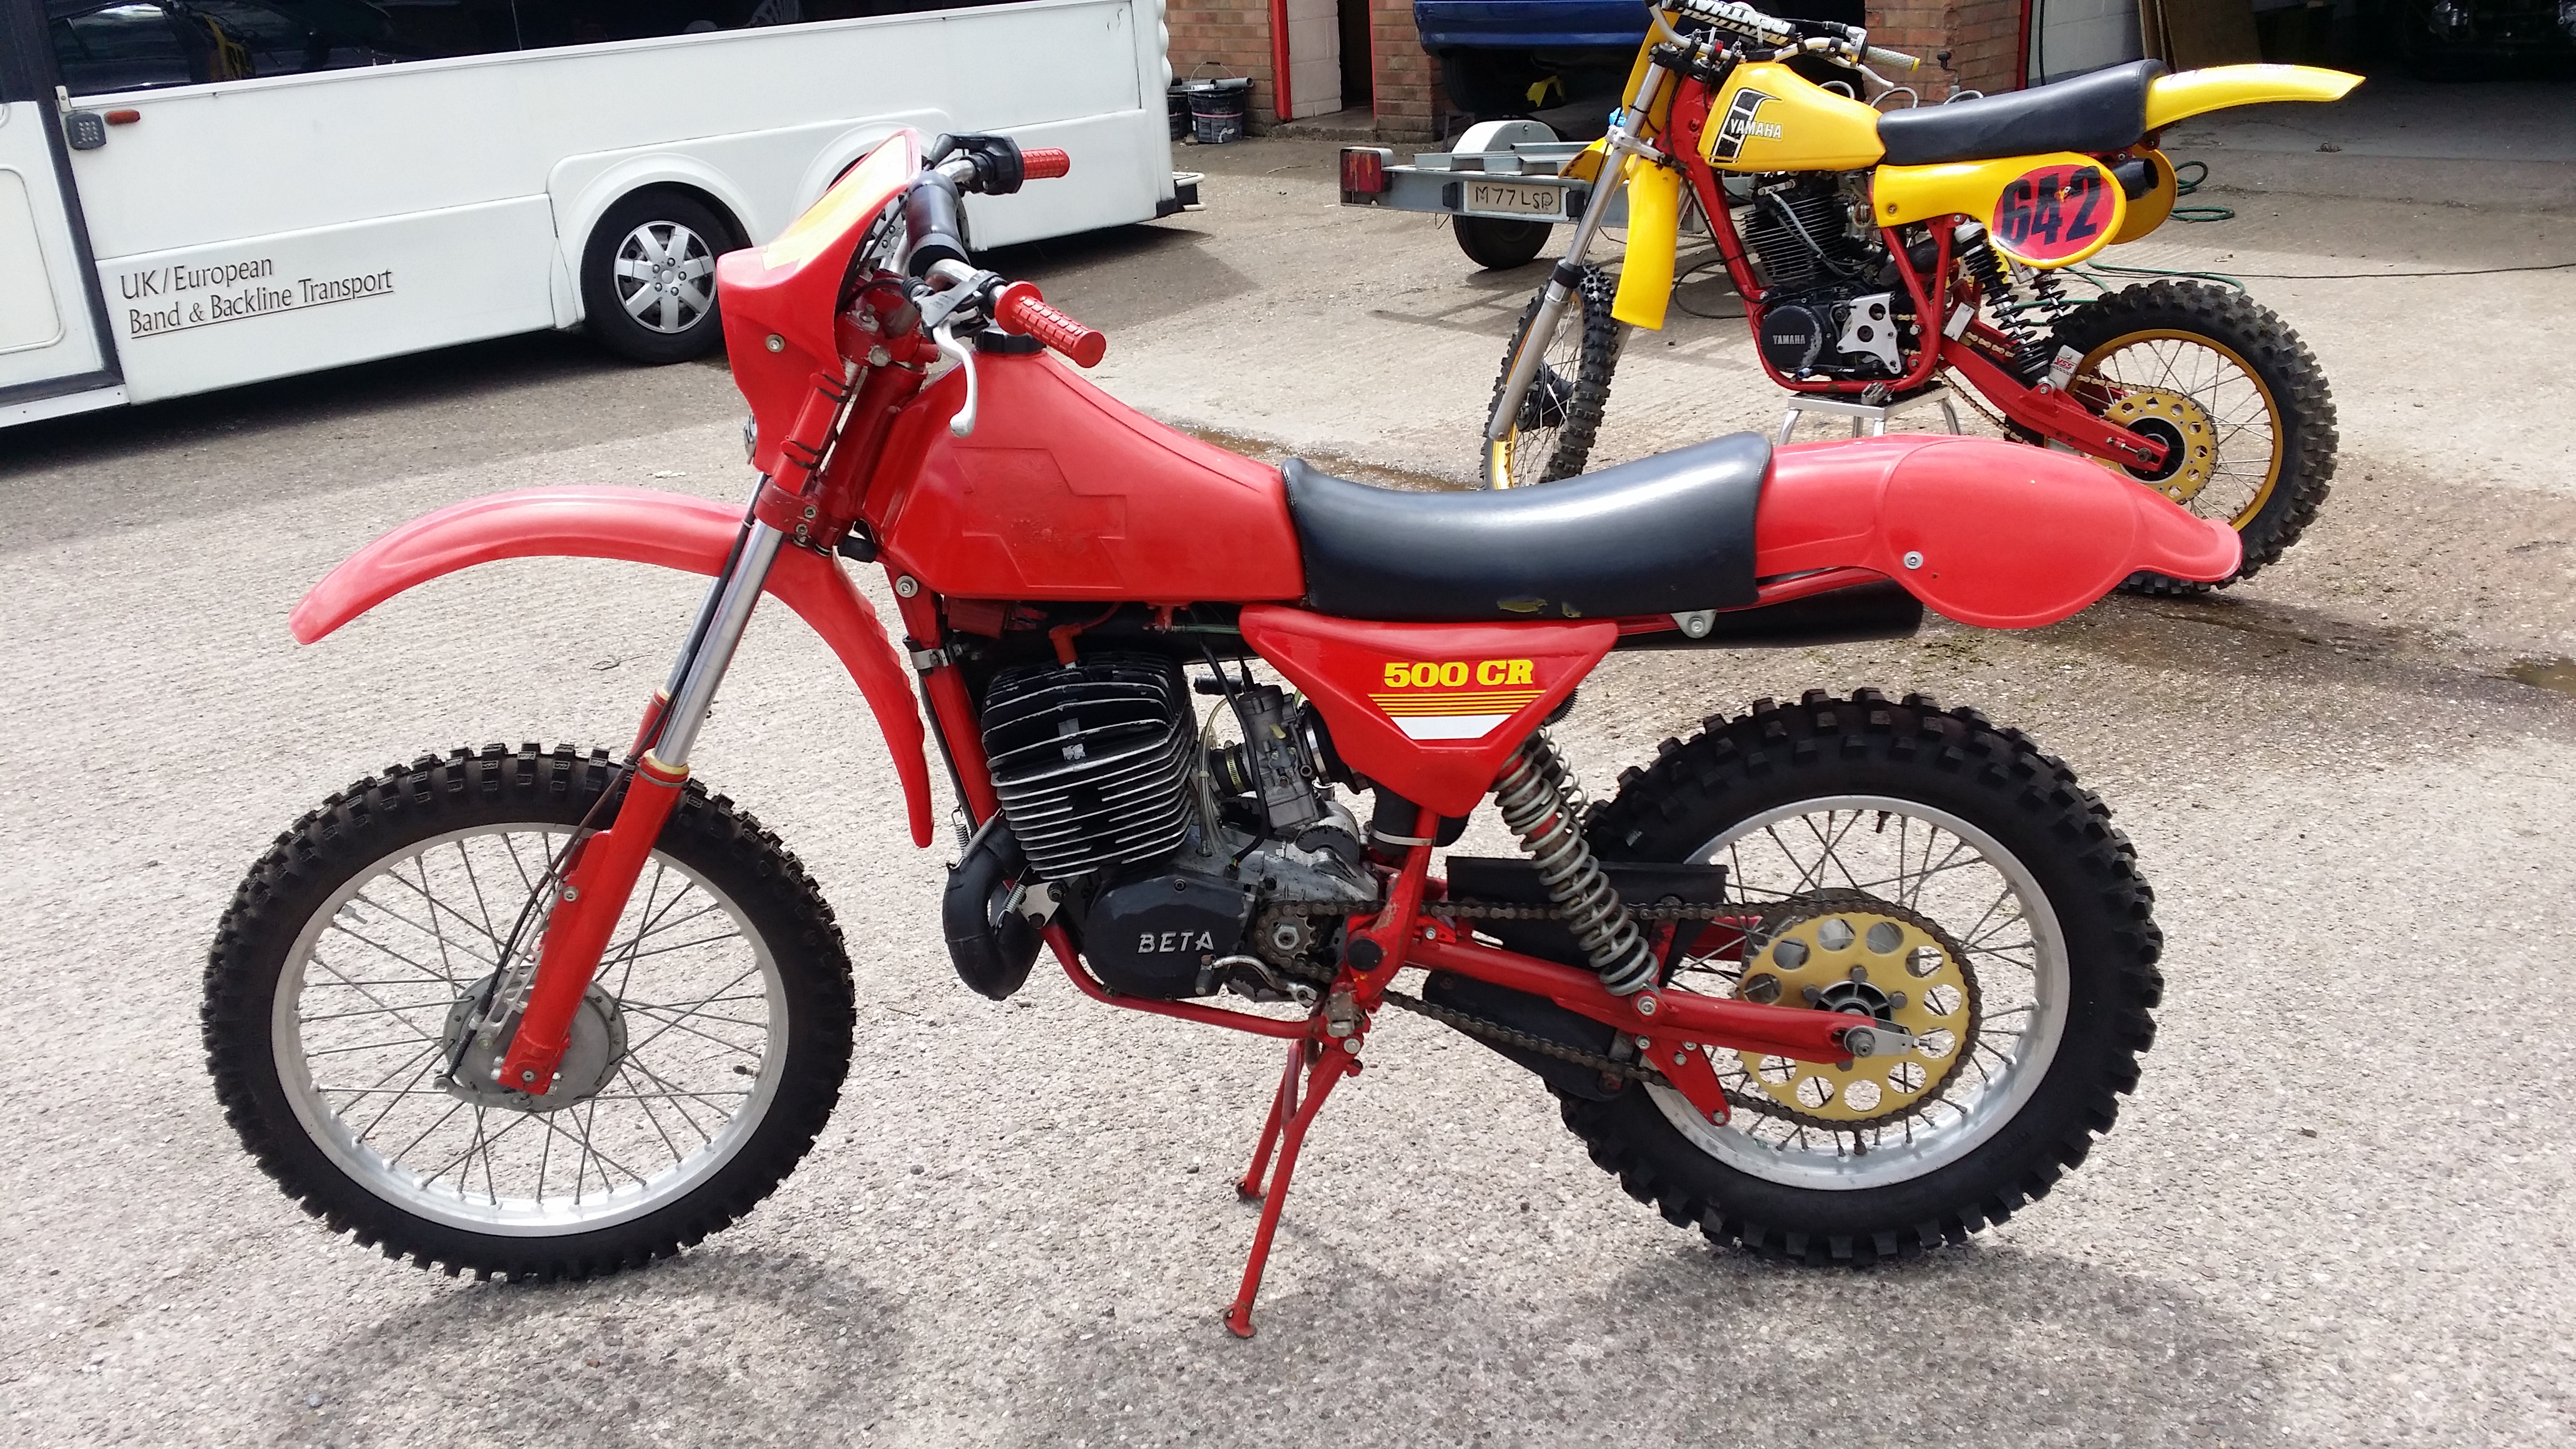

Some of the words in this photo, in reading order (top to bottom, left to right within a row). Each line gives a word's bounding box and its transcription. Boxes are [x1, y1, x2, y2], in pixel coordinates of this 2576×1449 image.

[1730, 118, 1782, 139] YAMAHA
[2001, 165, 2100, 247] 642
[129, 301, 180, 334] Band
[189, 303, 204, 323] &
[210, 287, 292, 319] Backline
[298, 268, 392, 303] Transport
[1772, 334, 1806, 344] YAMAHA
[1383, 662, 1469, 688] 500
[1476, 659, 1534, 685] CR
[1138, 930, 1214, 954] BETA
